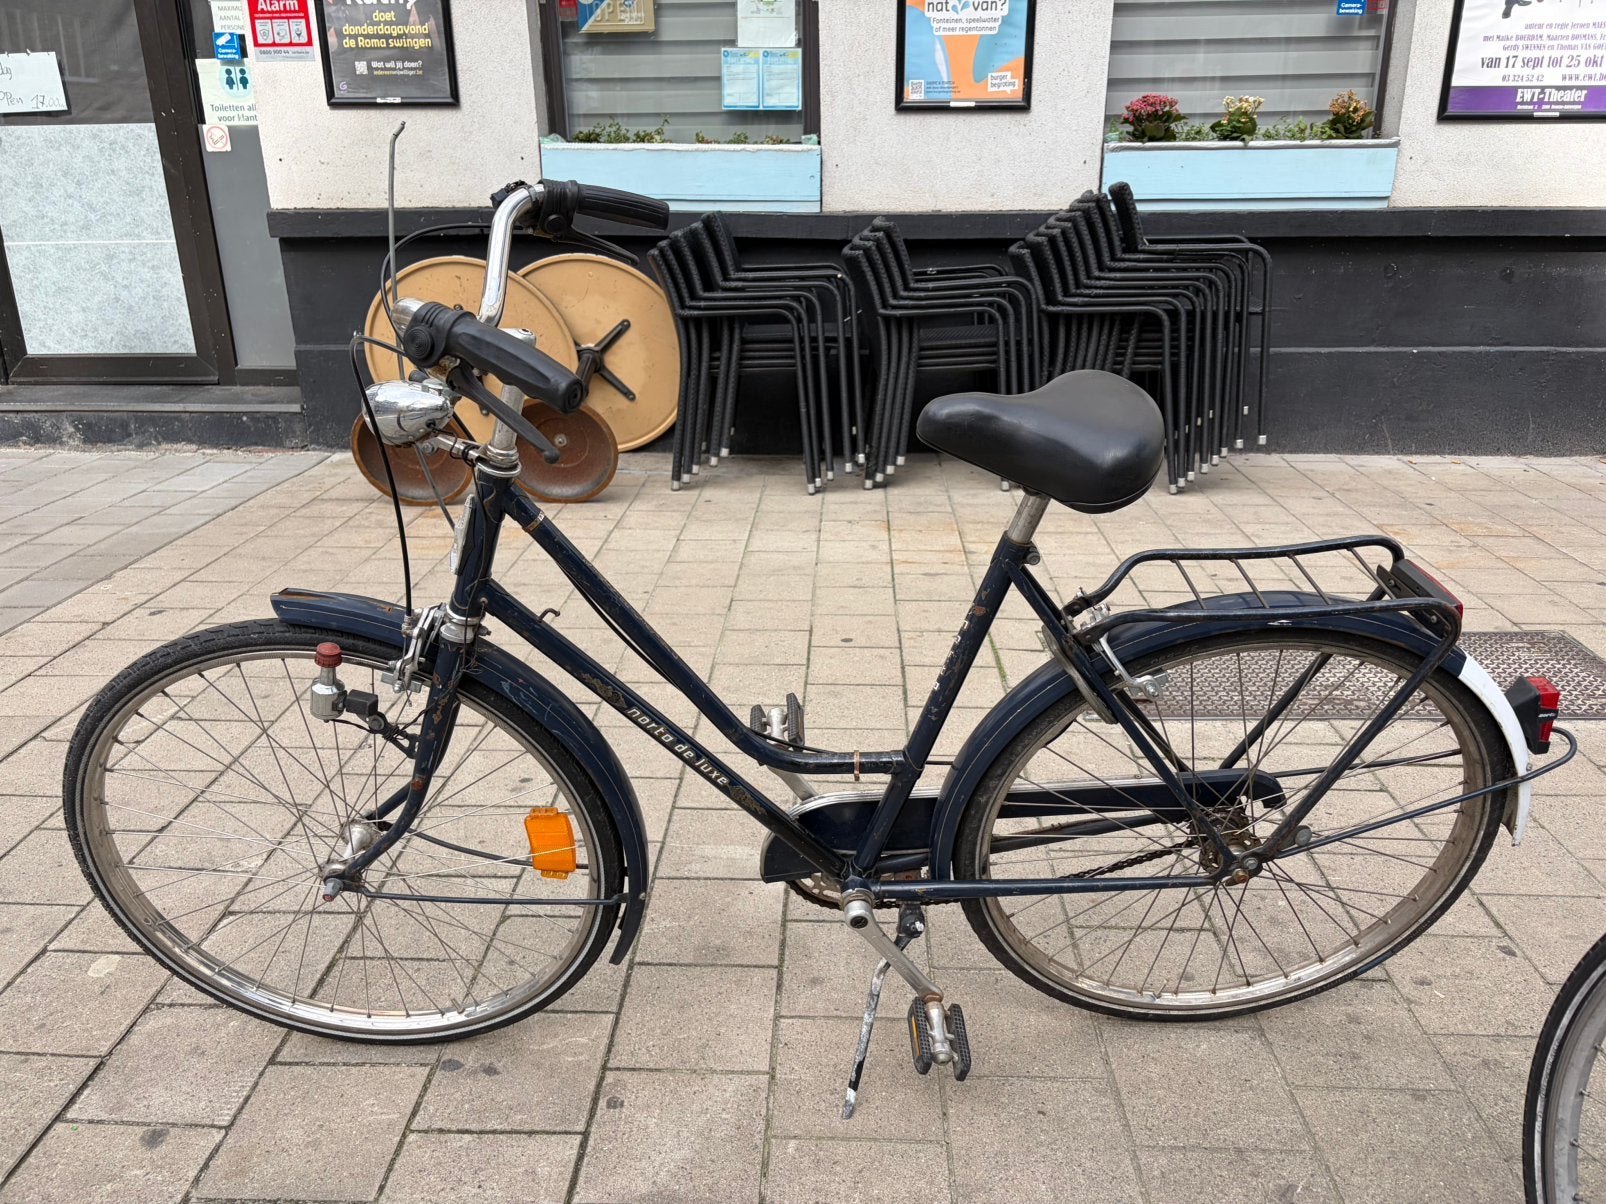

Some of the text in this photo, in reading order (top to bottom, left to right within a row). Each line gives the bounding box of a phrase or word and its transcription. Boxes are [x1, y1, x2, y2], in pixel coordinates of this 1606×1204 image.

[257, 0, 299, 11] Alarm
[927, 0, 1006, 12] nat van?
[372, 10, 396, 21] doet
[965, 16, 1000, 25] speelwater
[342, 23, 429, 36] donderdagavond
[958, 26, 997, 34] regentonnen
[343, 36, 432, 49] de Roma swingen
[403, 60, 422, 68] doen?
[1480, 54, 1604, 70] van 17 sept tot 25 okt
[990, 74, 1008, 82] burger
[1501, 74, 1510, 82] 03
[1511, 74, 1523, 82] 324
[1525, 74, 1534, 82] 52
[1536, 74, 1545, 82] 42
[990, 80, 1016, 90] begroting
[1516, 88, 1588, 103] EWT-Theater
[210, 104, 245, 112] Toiletten
[674, 743, 695, 759] de
[695, 758, 729, 786] luxe
